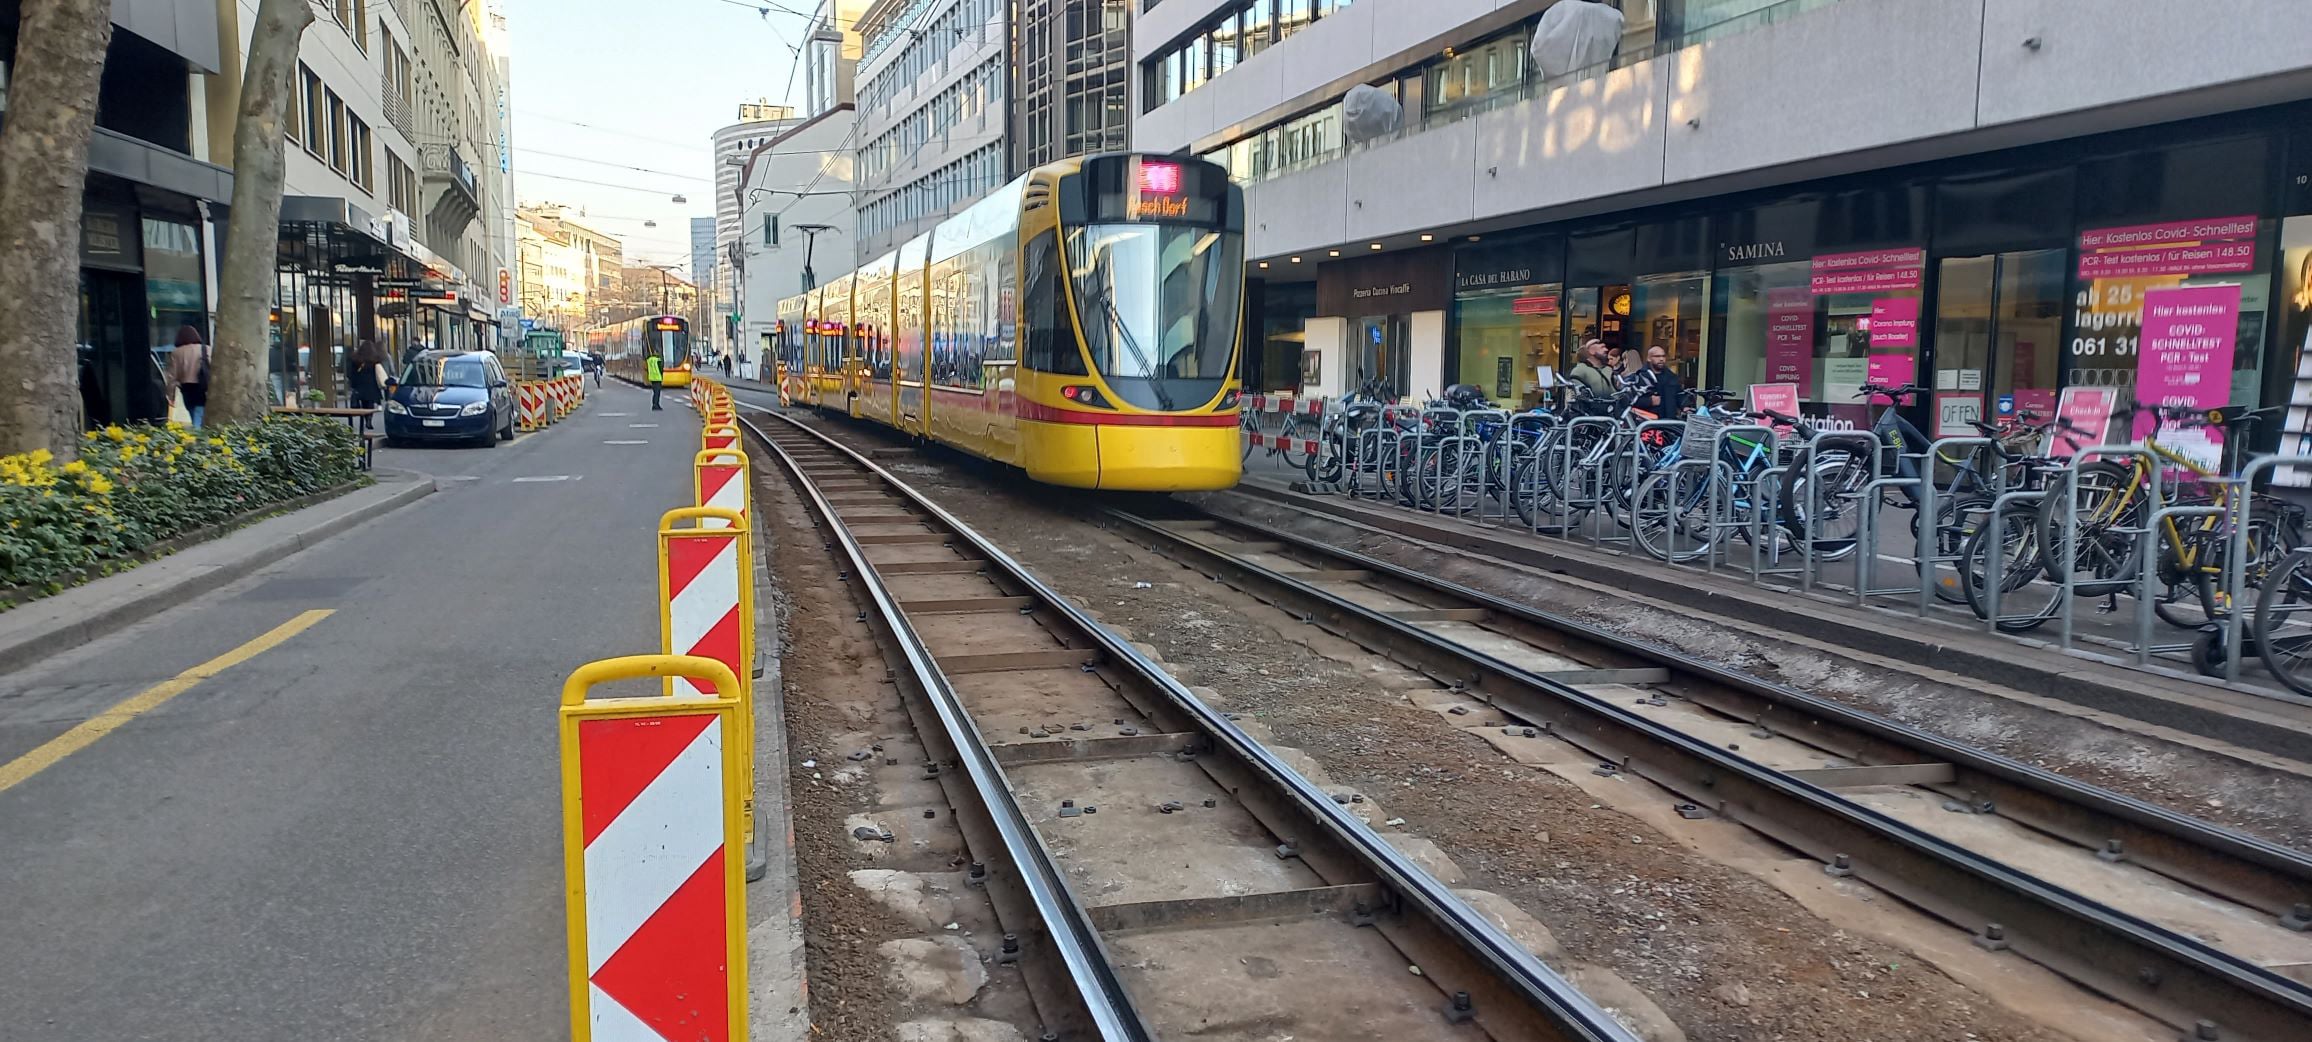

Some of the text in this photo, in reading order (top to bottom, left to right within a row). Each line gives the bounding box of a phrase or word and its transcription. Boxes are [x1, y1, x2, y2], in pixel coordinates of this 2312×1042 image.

[1162, 195, 1189, 217] Dorf
[2082, 221, 2254, 246] Hier: Kostenlos Covid- Schnelltest
[1728, 241, 1785, 261] SAMINA
[1828, 257, 1857, 267] Kostenlos
[1858, 255, 1881, 264] Covid-
[1882, 252, 1920, 263] Schnelltest
[2082, 255, 2101, 267] PCR-
[2103, 254, 2119, 265] Test
[2121, 252, 2160, 263] kostenlos
[2168, 249, 2180, 261] für
[2182, 247, 2213, 259] Reisen
[2217, 245, 2250, 257] 148.50
[1470, 273, 1487, 286] CASA
[1500, 269, 1531, 283] HABANO
[1897, 269, 1918, 279] 148.50
[2153, 305, 2173, 317] Hier
[1772, 324, 1807, 332] SCHNELLTEST
[2072, 337, 2106, 356] 061
[2152, 338, 2223, 351] SCHNELLTEST
[1942, 405, 1980, 423] OFFEN
